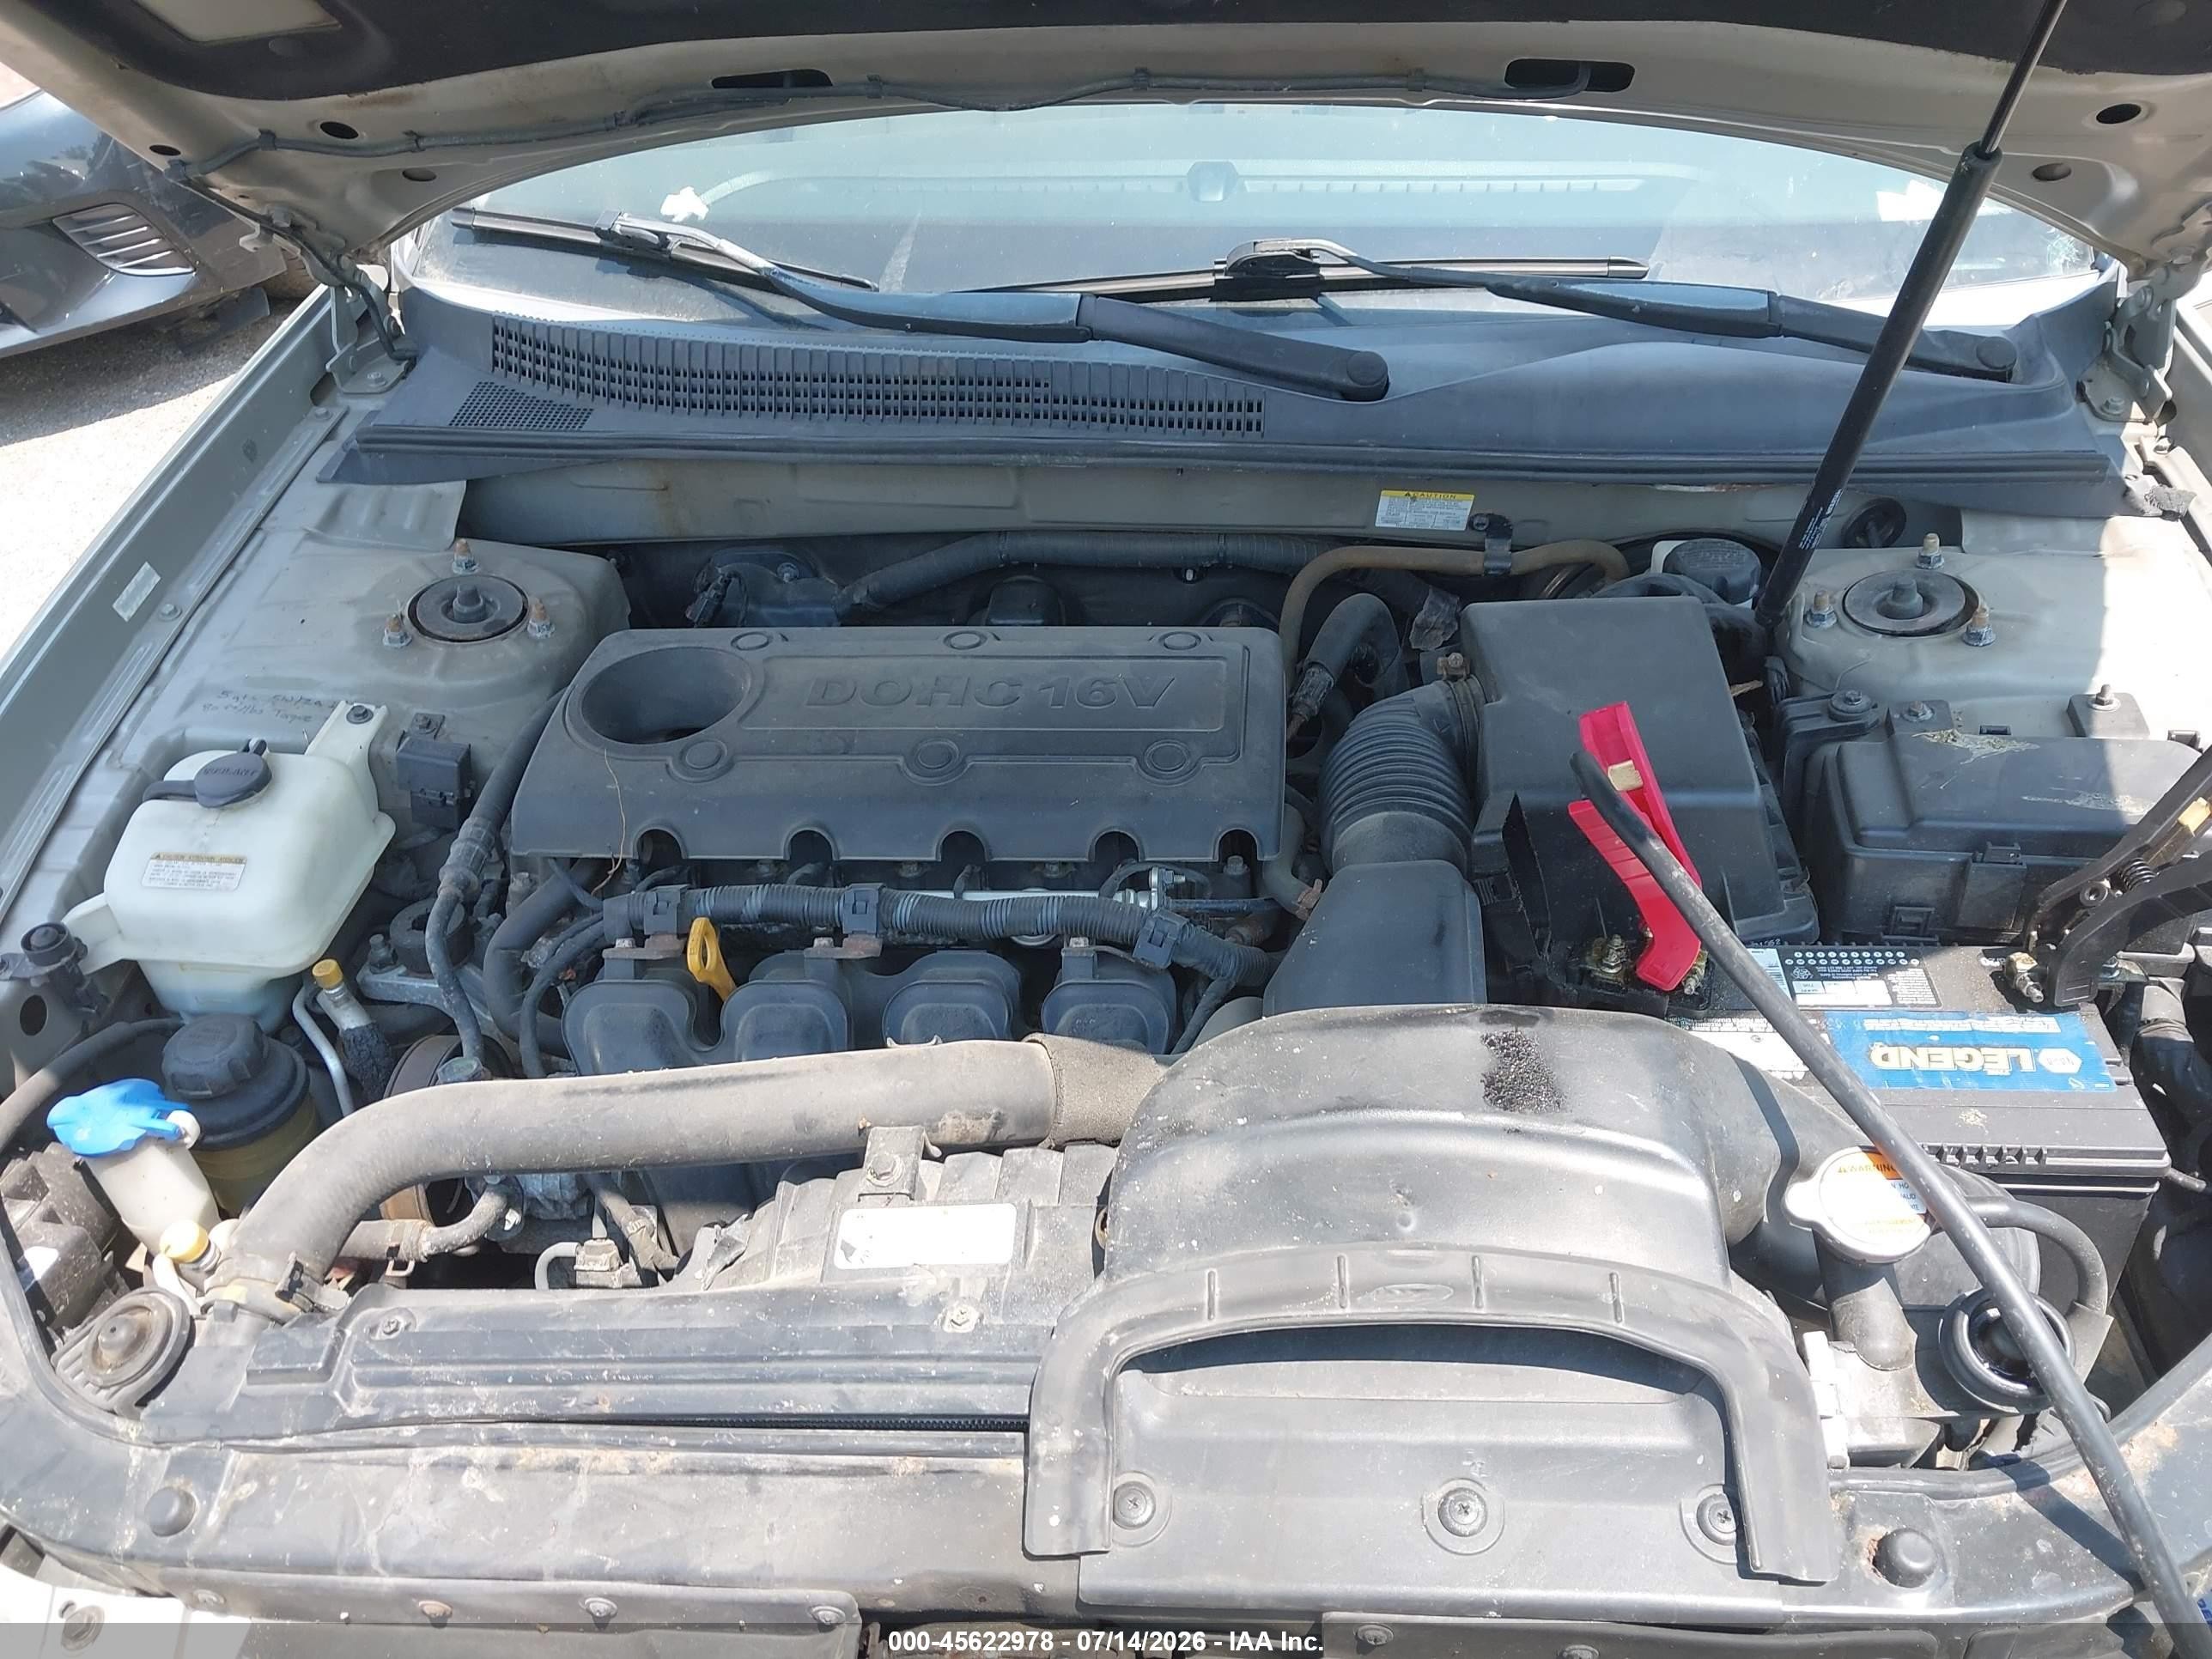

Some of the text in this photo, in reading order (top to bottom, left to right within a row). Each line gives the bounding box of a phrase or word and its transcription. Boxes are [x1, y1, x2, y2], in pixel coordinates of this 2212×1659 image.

[805, 675, 1176, 709] DOHC 16V
[1870, 1045, 2036, 1072] LEGEND
